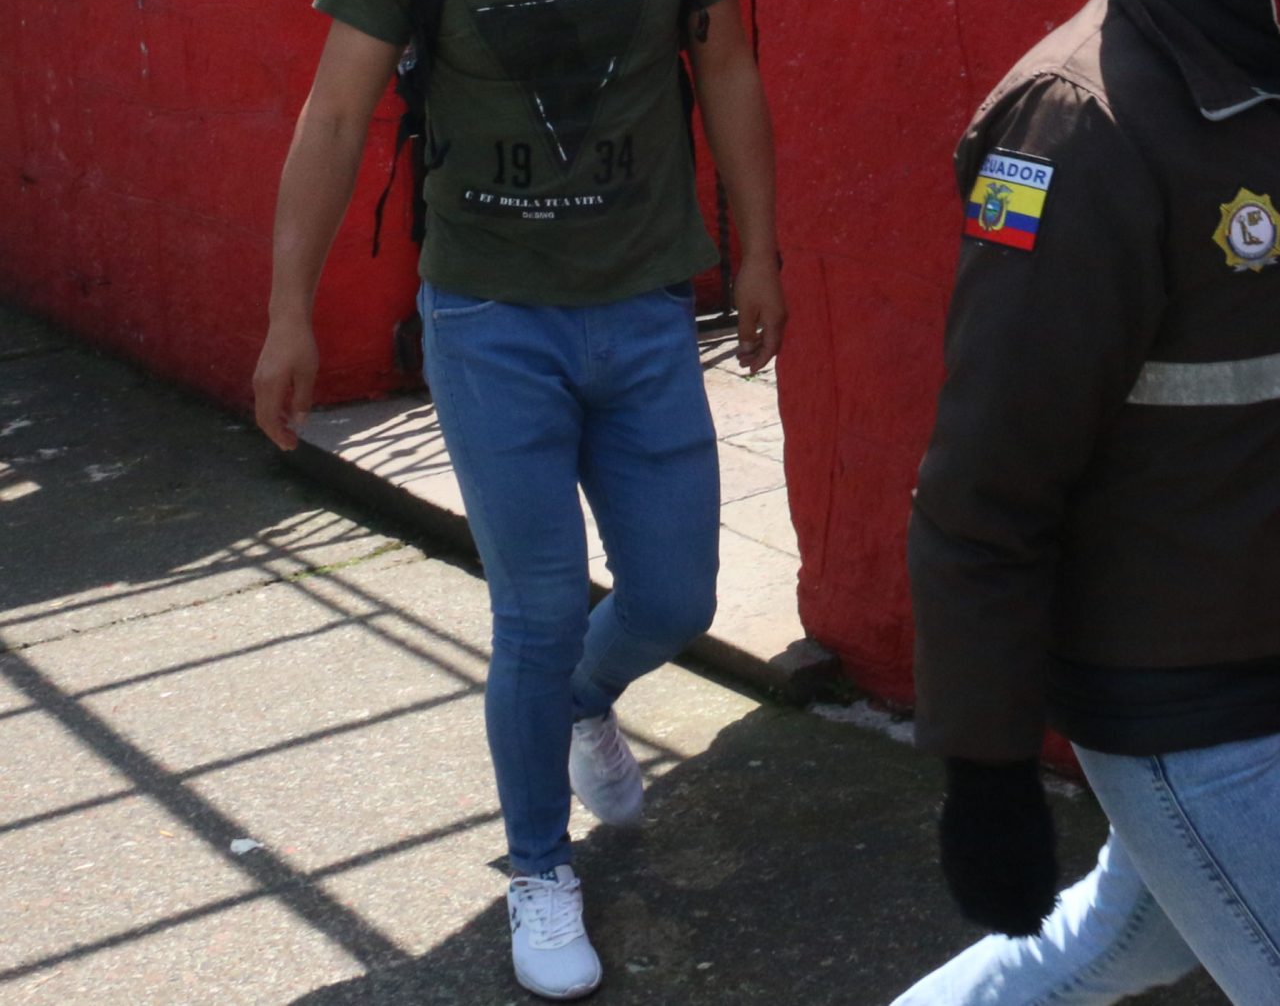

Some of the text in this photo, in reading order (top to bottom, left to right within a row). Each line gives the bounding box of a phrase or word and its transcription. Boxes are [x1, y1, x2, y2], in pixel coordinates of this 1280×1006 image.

[493, 132, 635, 187] 19 34
[982, 157, 1047, 185] CUADOR
[574, 195, 604, 206] VITA
